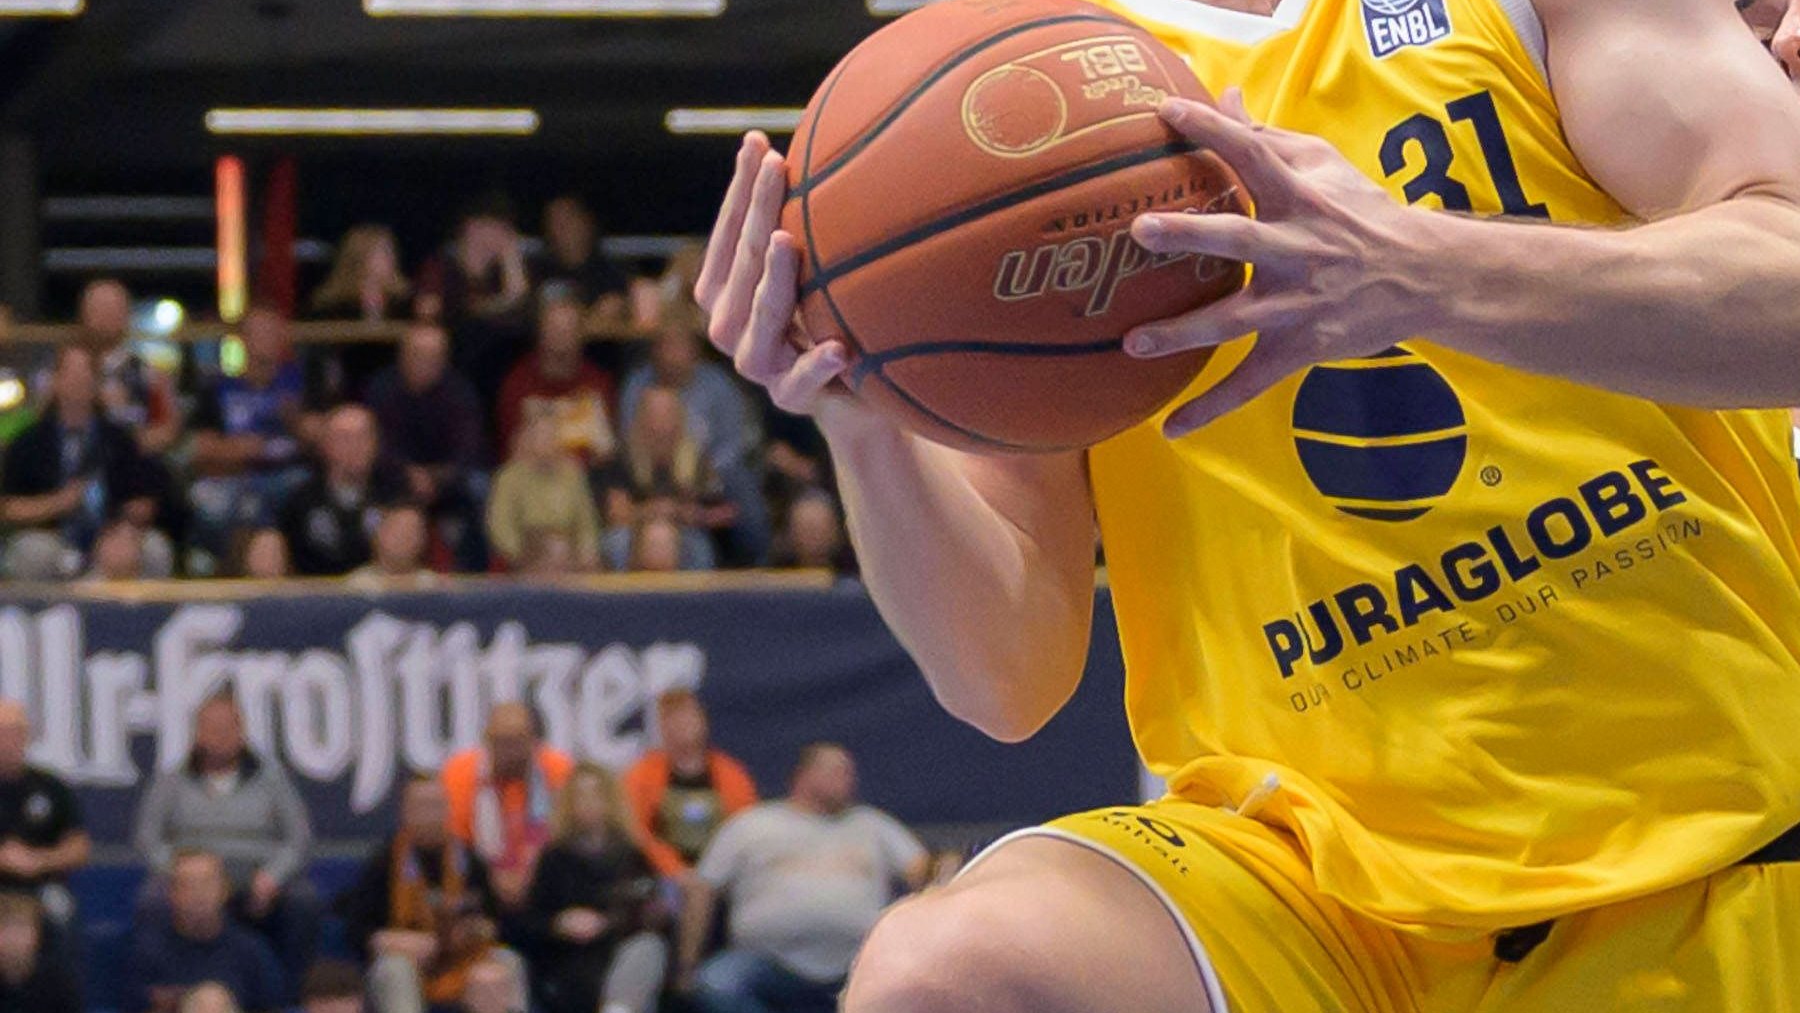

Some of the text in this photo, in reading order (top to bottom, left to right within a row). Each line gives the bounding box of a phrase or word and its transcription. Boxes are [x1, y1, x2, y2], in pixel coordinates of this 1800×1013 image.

[1061, 44, 1148, 79] BBL
[1371, 2, 1446, 54] ENBL
[1378, 90, 1552, 222] 31
[1263, 459, 1688, 679] PURAGLOBE
[1497, 584, 1560, 625] OUR
[1570, 517, 1702, 590] PASSION
